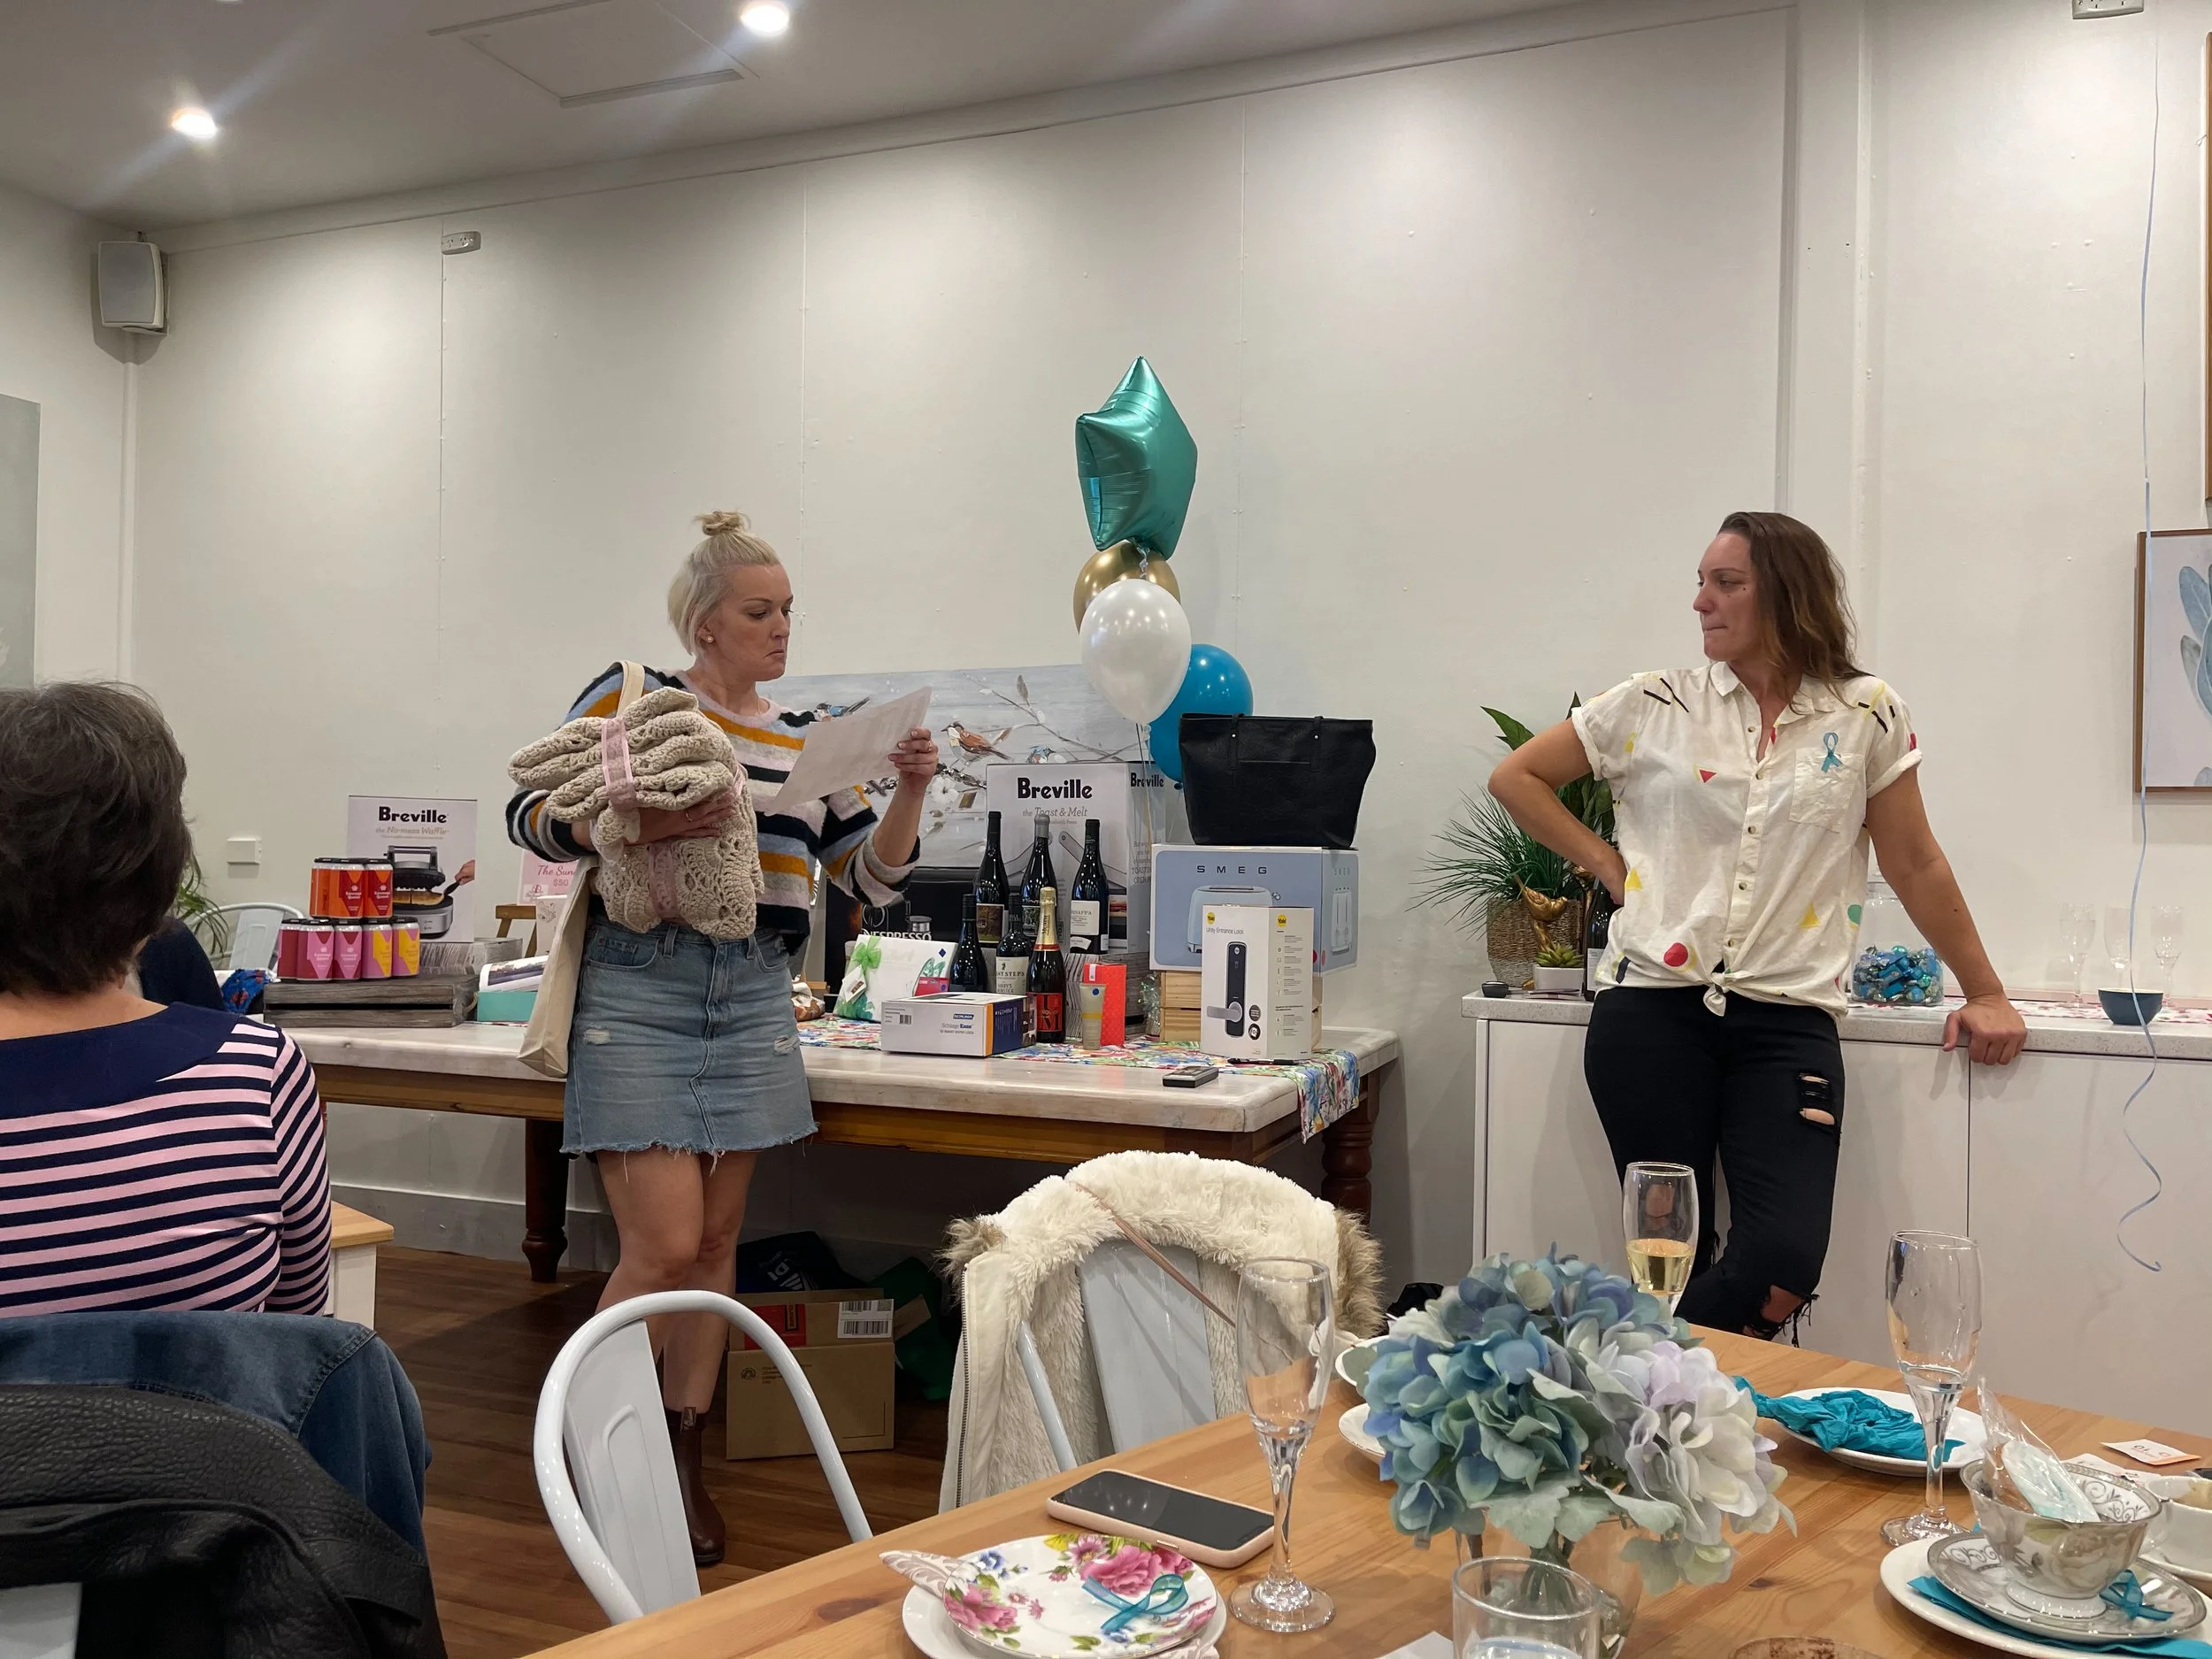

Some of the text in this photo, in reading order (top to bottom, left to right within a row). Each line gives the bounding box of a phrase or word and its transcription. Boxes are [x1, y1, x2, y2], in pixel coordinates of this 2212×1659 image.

[1130, 772, 1164, 787] Breville
[1017, 777, 1093, 799] Breville
[379, 806, 447, 824] Breville
[1059, 807, 1068, 817] &
[1068, 806, 1088, 817] Melt
[538, 864, 574, 877] The Sun
[1196, 865, 1267, 874] SMEG
